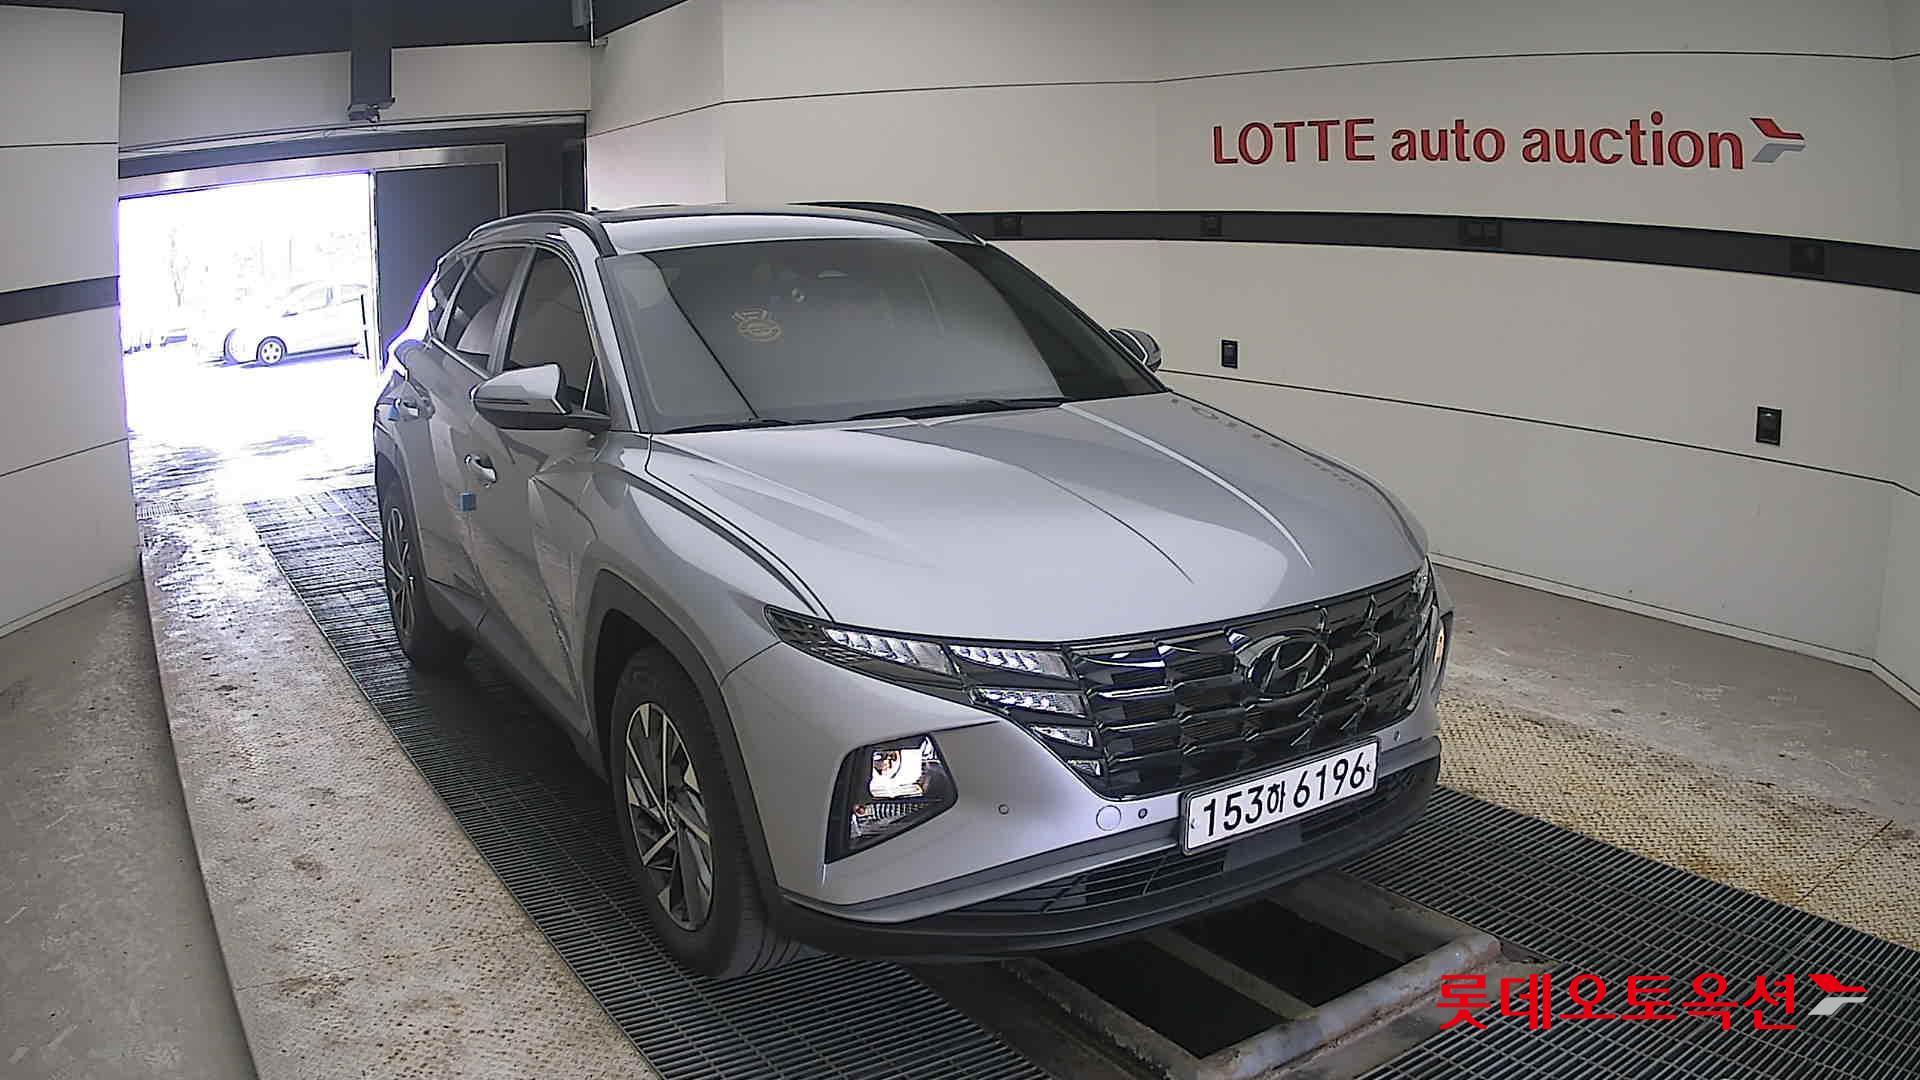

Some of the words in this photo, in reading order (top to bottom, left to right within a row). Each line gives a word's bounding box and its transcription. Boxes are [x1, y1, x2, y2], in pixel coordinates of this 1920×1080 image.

[1213, 117, 1376, 165] LOTTE
[1390, 118, 1506, 163] auto
[1522, 111, 1744, 170] auction
[1293, 752, 1366, 809] 6196
